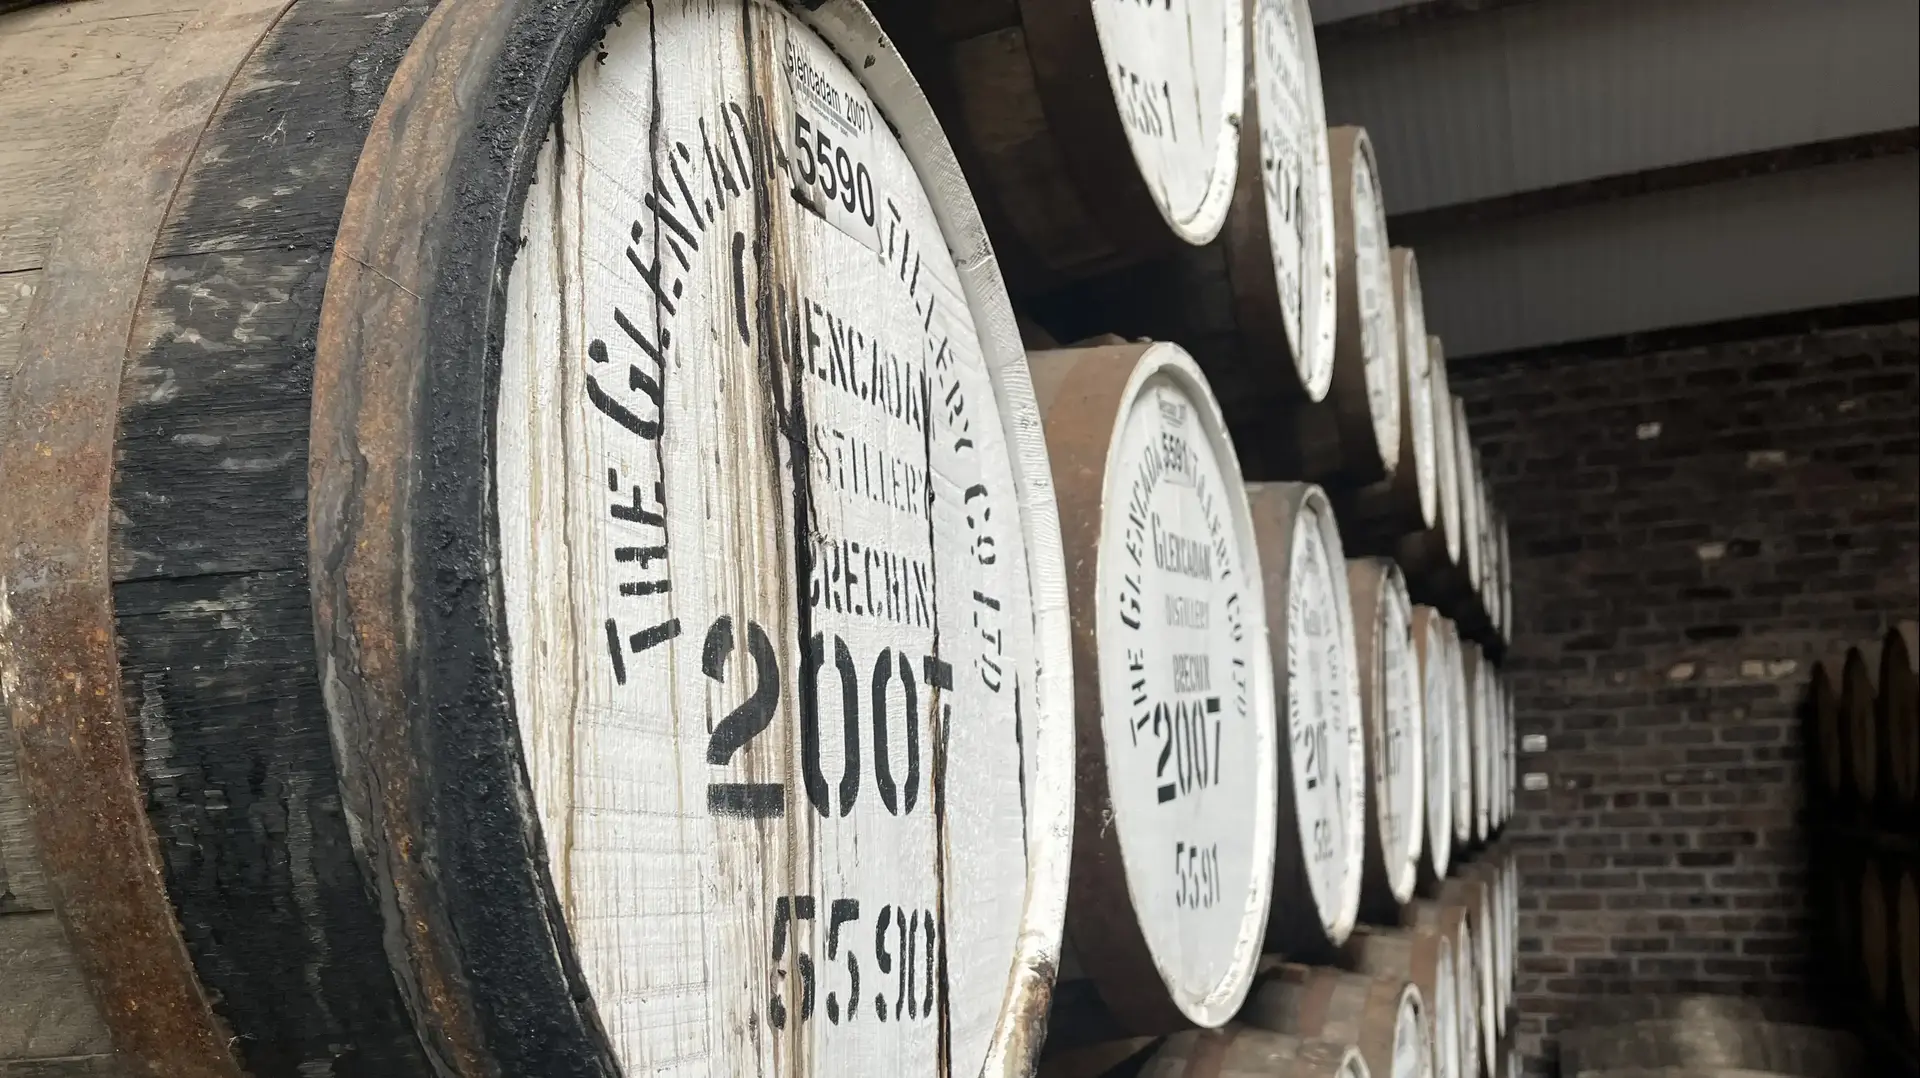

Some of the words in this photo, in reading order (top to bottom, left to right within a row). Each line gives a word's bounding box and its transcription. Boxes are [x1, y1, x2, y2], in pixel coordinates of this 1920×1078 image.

[784, 38, 842, 115] Glencadam
[844, 91, 867, 135] 2007
[795, 111, 876, 228] 5590
[603, 467, 682, 686] THE
[702, 613, 954, 819] 2007
[1129, 648, 1151, 748] THE
[1153, 696, 1221, 805] 2007
[1175, 841, 1221, 910] 5591
[769, 894, 934, 1031] 5590
